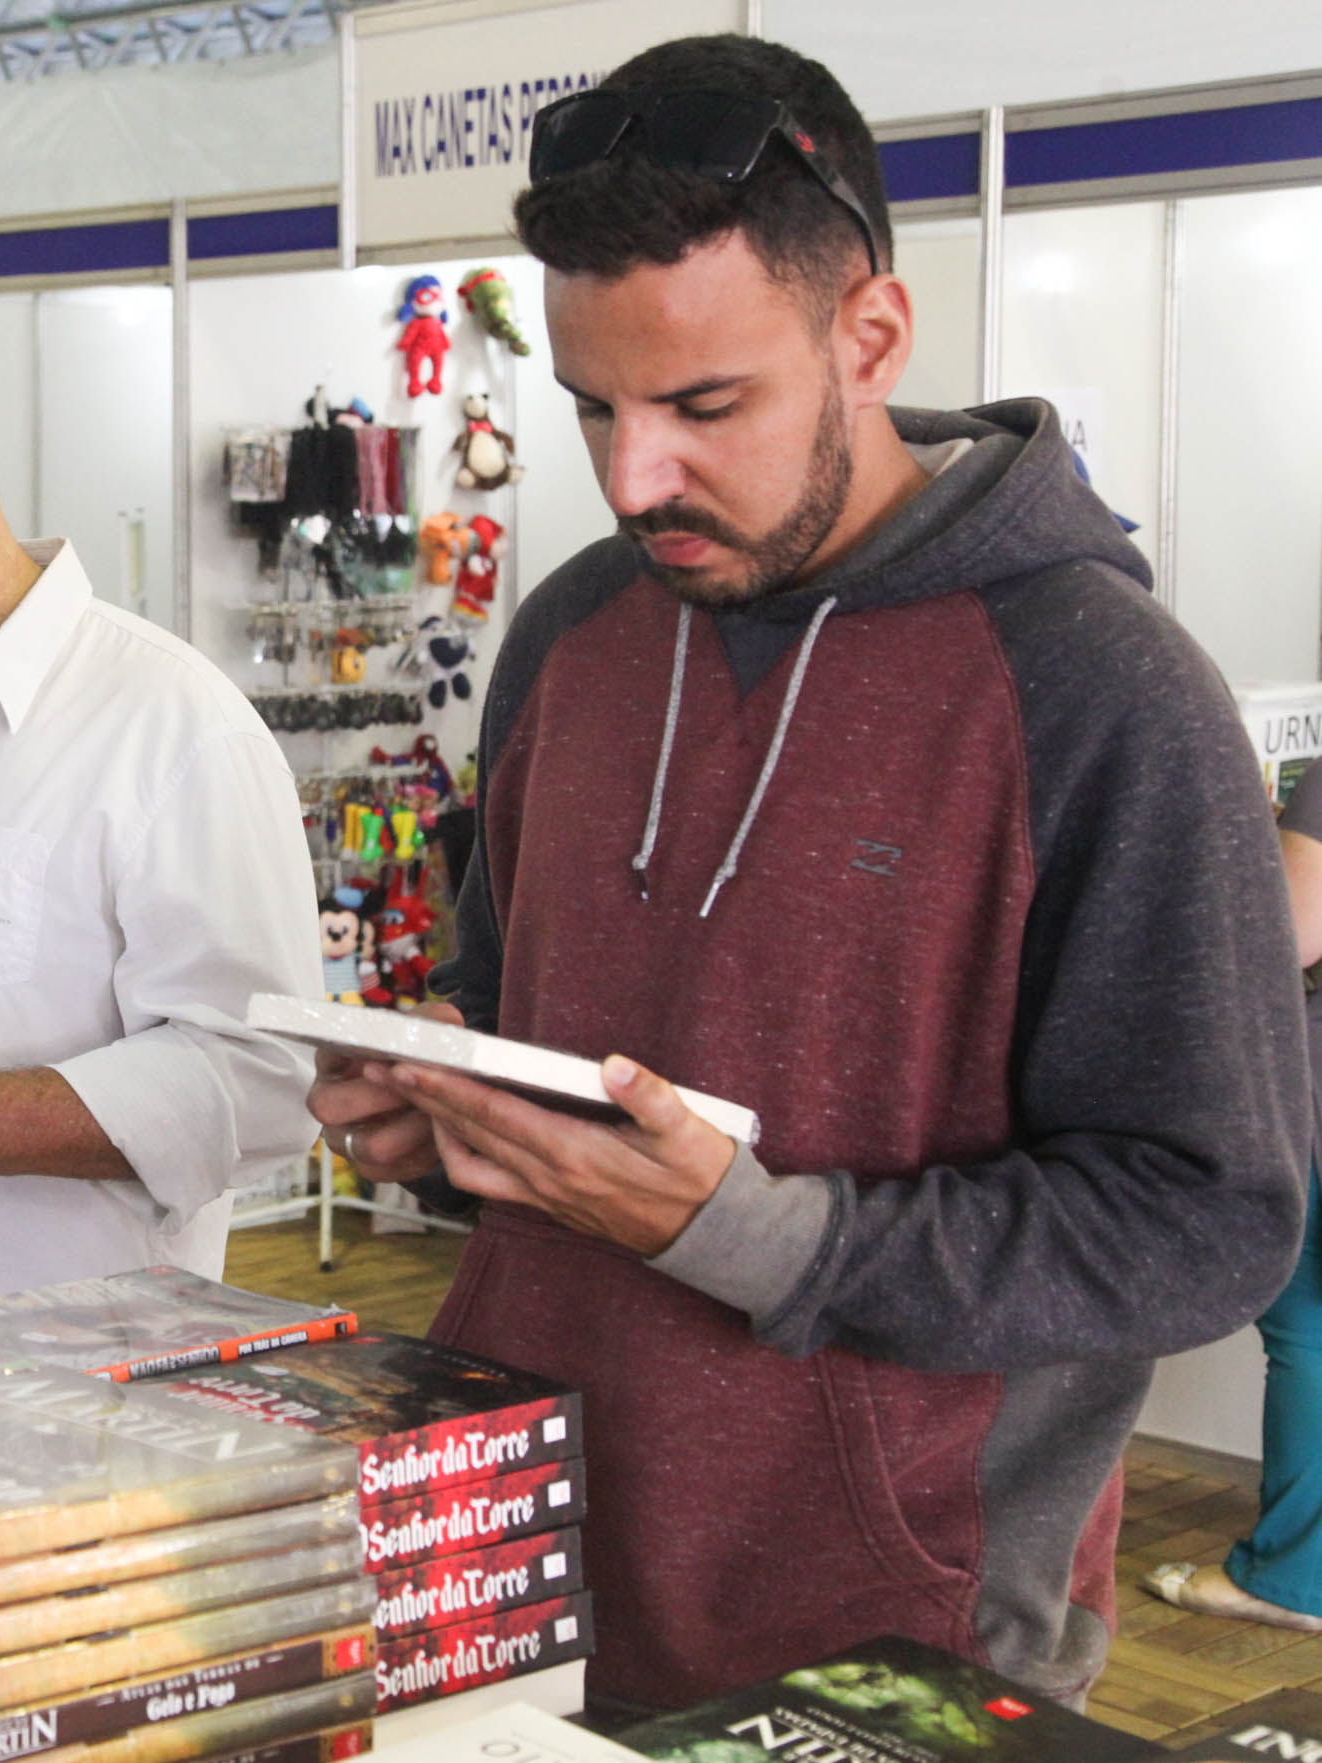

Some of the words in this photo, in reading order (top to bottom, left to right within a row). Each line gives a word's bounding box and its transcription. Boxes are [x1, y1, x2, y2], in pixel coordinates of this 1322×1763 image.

[376, 96, 416, 177] MAX
[421, 83, 514, 173] CANETAS
[362, 1444, 441, 1495] Senhor
[442, 1436, 468, 1476] da
[465, 1429, 530, 1470] Torre
[368, 1511, 447, 1562] Senhor
[447, 1501, 474, 1541] da
[470, 1494, 535, 1535] Torre
[371, 1582, 439, 1629] enhor
[440, 1573, 467, 1613] da
[462, 1566, 529, 1607] Torre
[375, 1650, 452, 1700] Senhor
[453, 1640, 479, 1679] da
[475, 1631, 541, 1672] Torre
